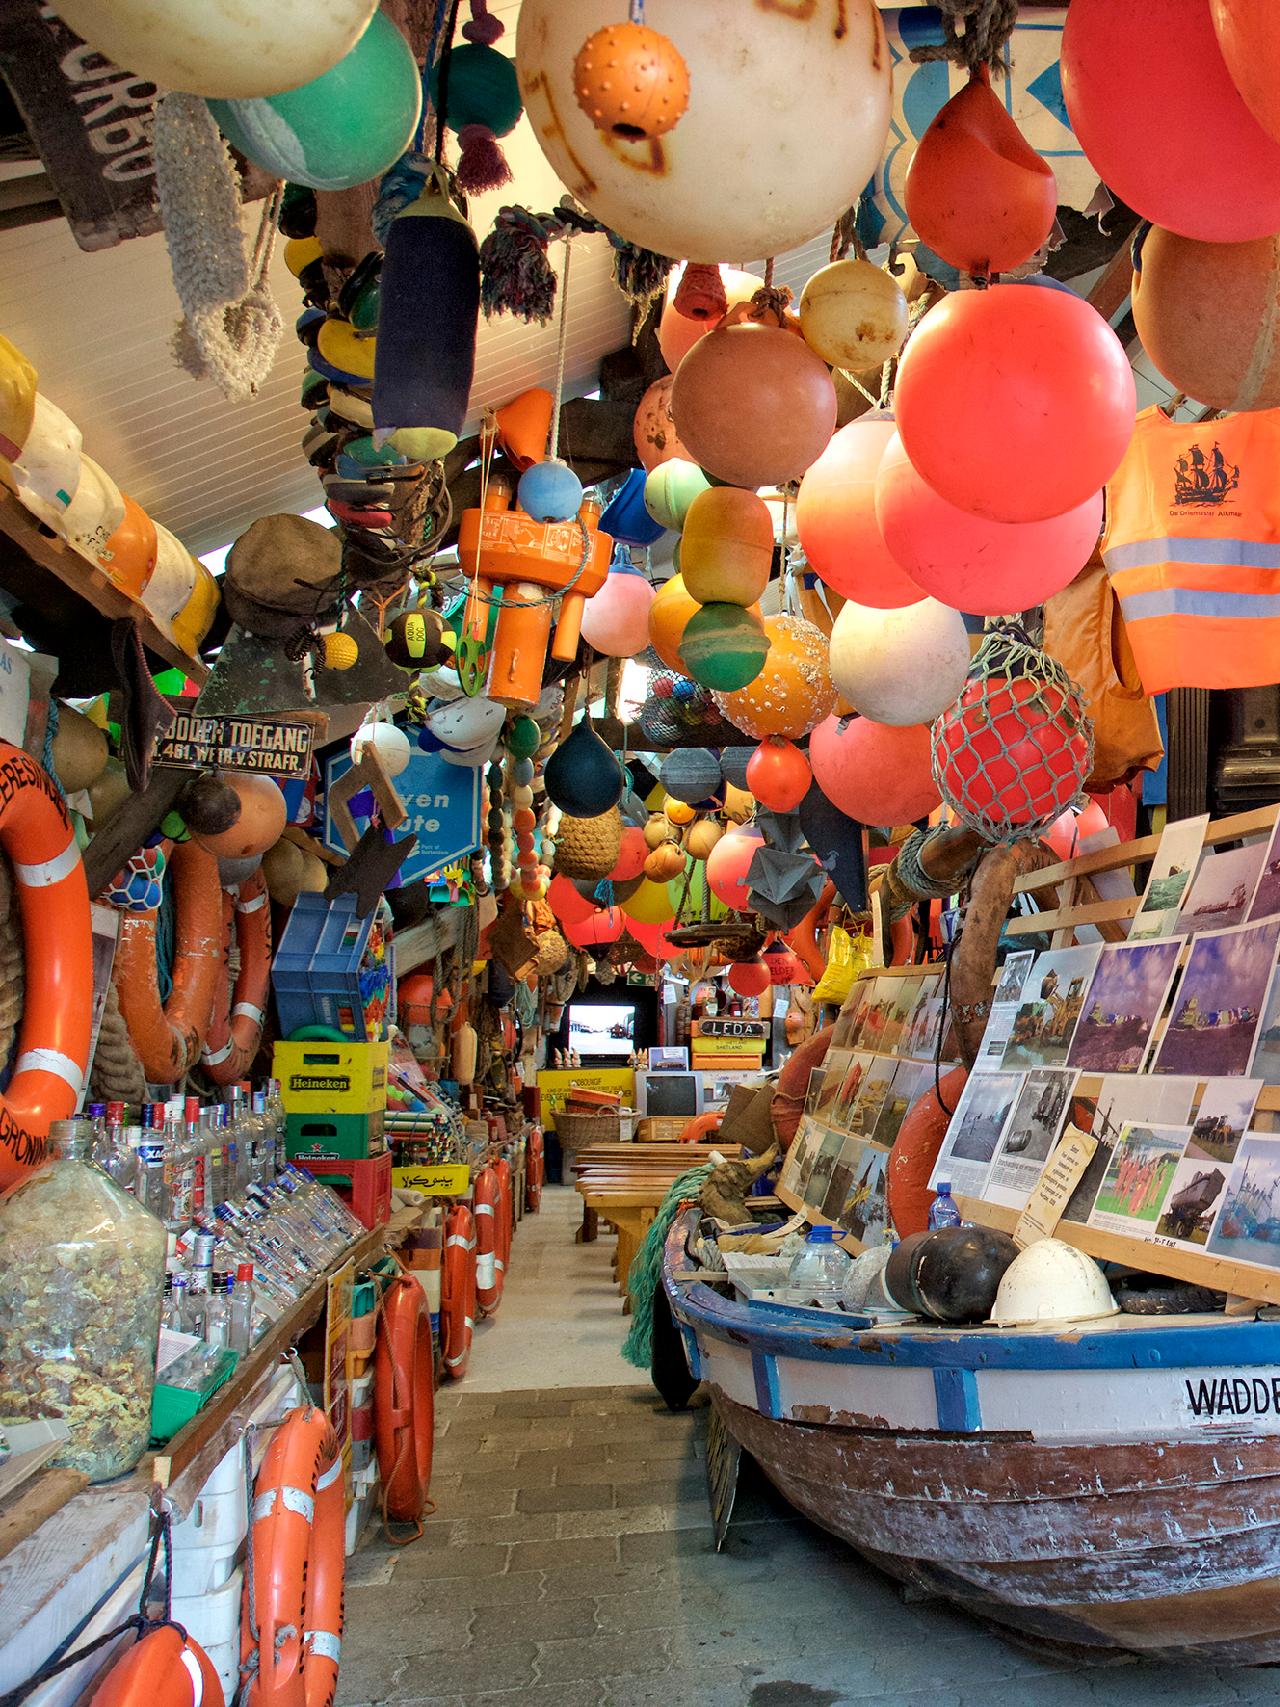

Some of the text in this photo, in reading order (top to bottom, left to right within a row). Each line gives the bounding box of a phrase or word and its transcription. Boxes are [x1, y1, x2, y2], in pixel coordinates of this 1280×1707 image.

[407, 620, 415, 642] AQUA
[230, 720, 308, 753] TOEGANG
[163, 742, 193, 761] 461.
[770, 966, 794, 977] ELDER
[292, 1077, 348, 1091] Heineken
